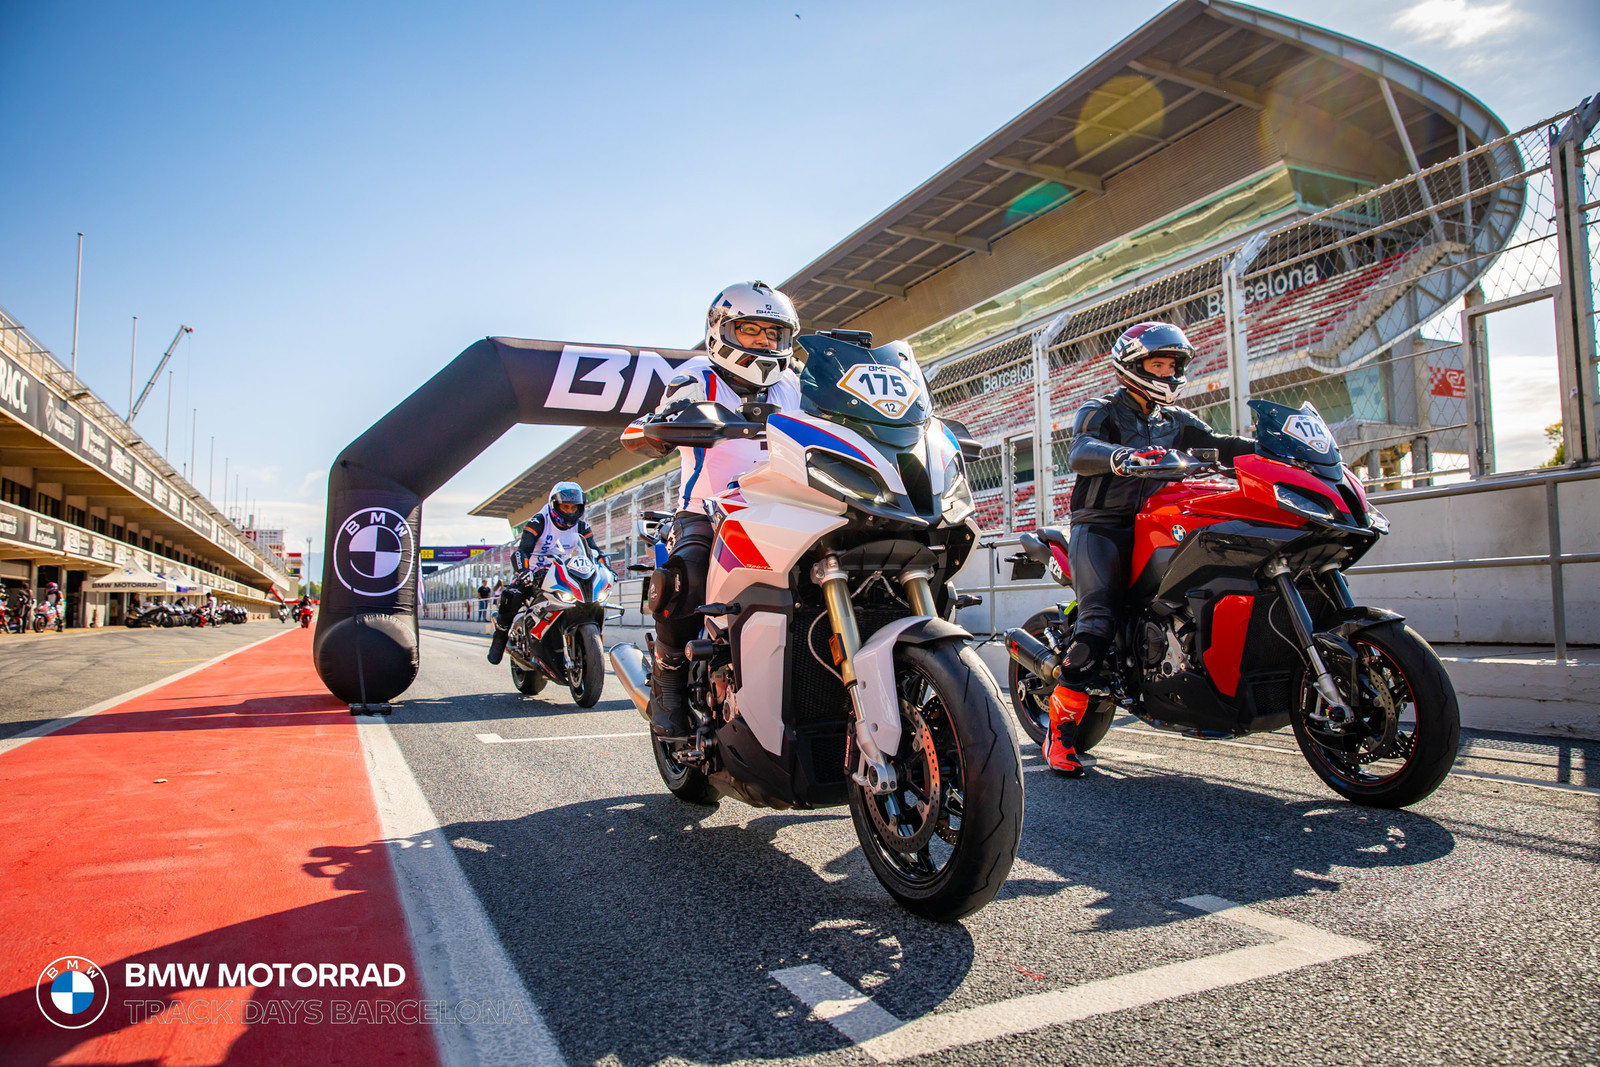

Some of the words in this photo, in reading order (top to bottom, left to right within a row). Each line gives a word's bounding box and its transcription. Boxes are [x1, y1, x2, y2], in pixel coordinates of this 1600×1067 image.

[1207, 263, 1318, 318] Bcelona
[858, 373, 907, 397] 175
[983, 362, 1034, 394] Barcelon
[884, 403, 896, 412] 12
[1295, 421, 1326, 439] 174
[345, 512, 408, 538] BMW
